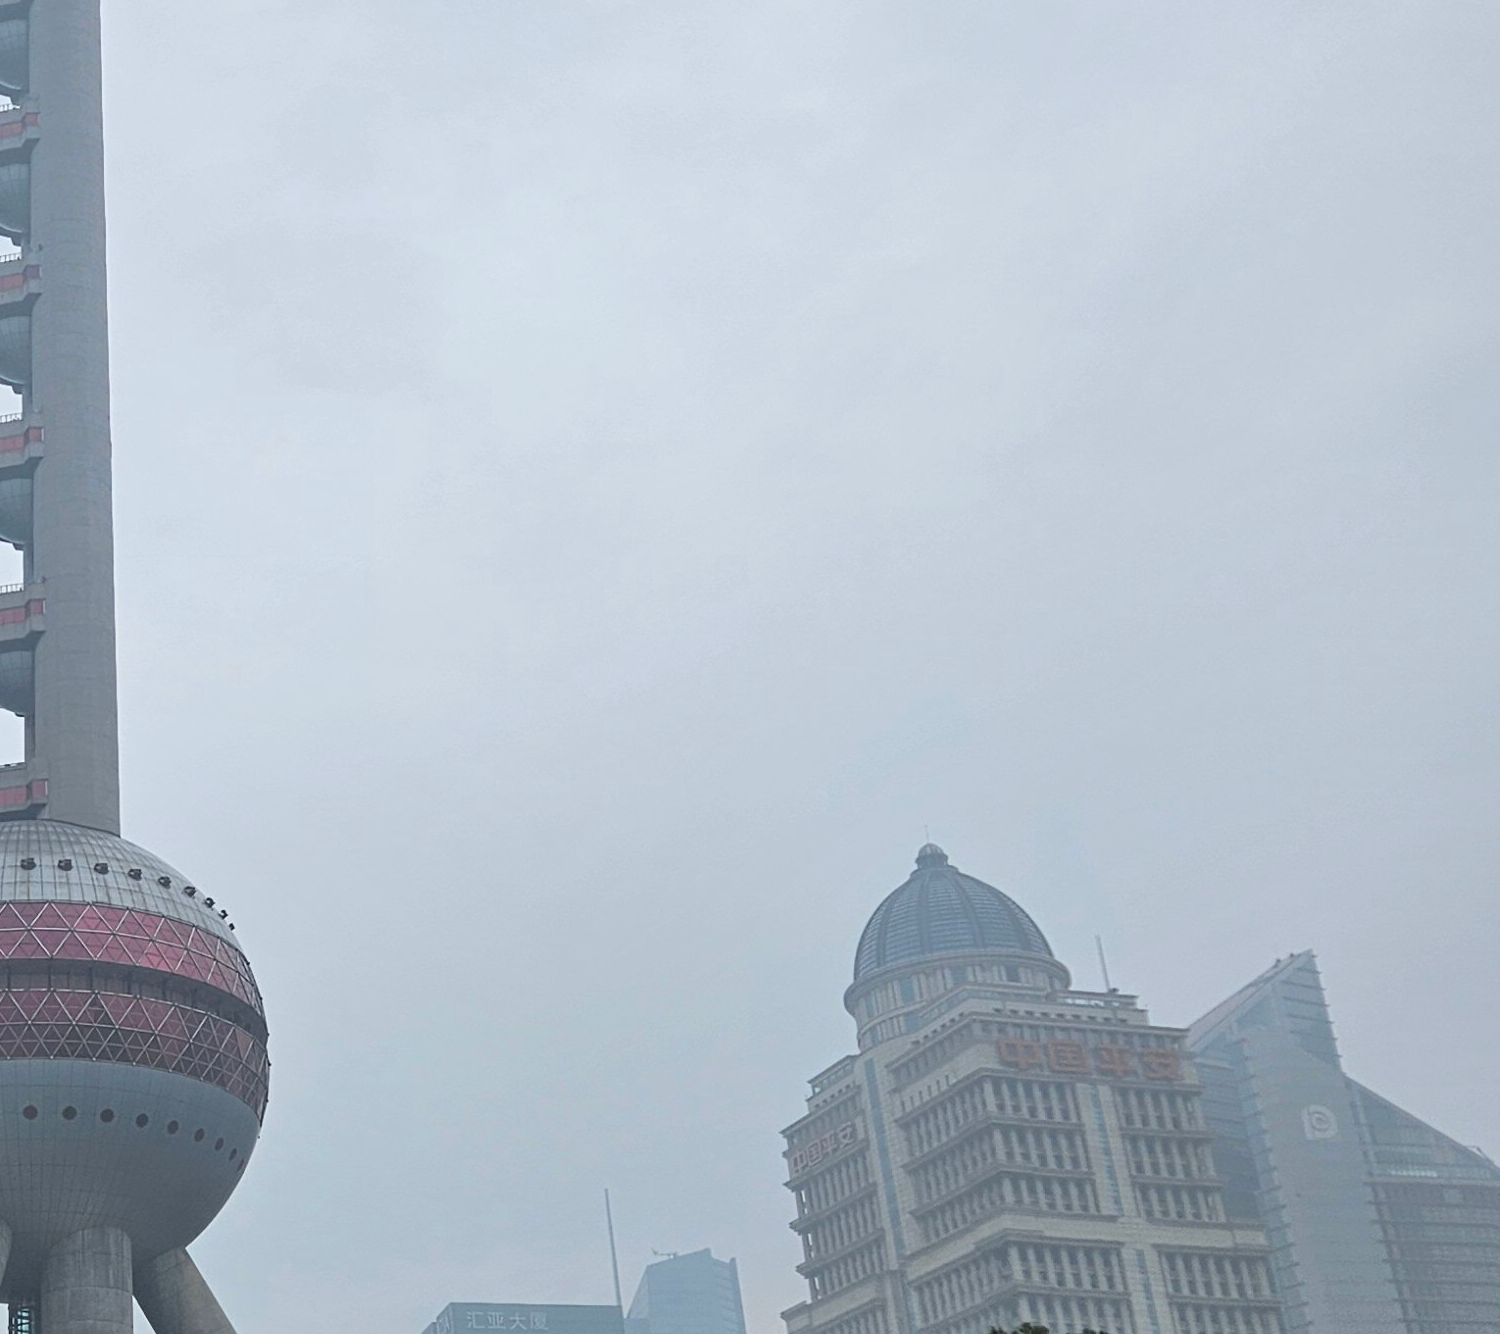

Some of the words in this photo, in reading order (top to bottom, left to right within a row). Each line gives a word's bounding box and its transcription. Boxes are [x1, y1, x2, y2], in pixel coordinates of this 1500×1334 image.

[997, 1036, 1186, 1080] 中国平安
[467, 1311, 549, 1331] 汇亚大厦
